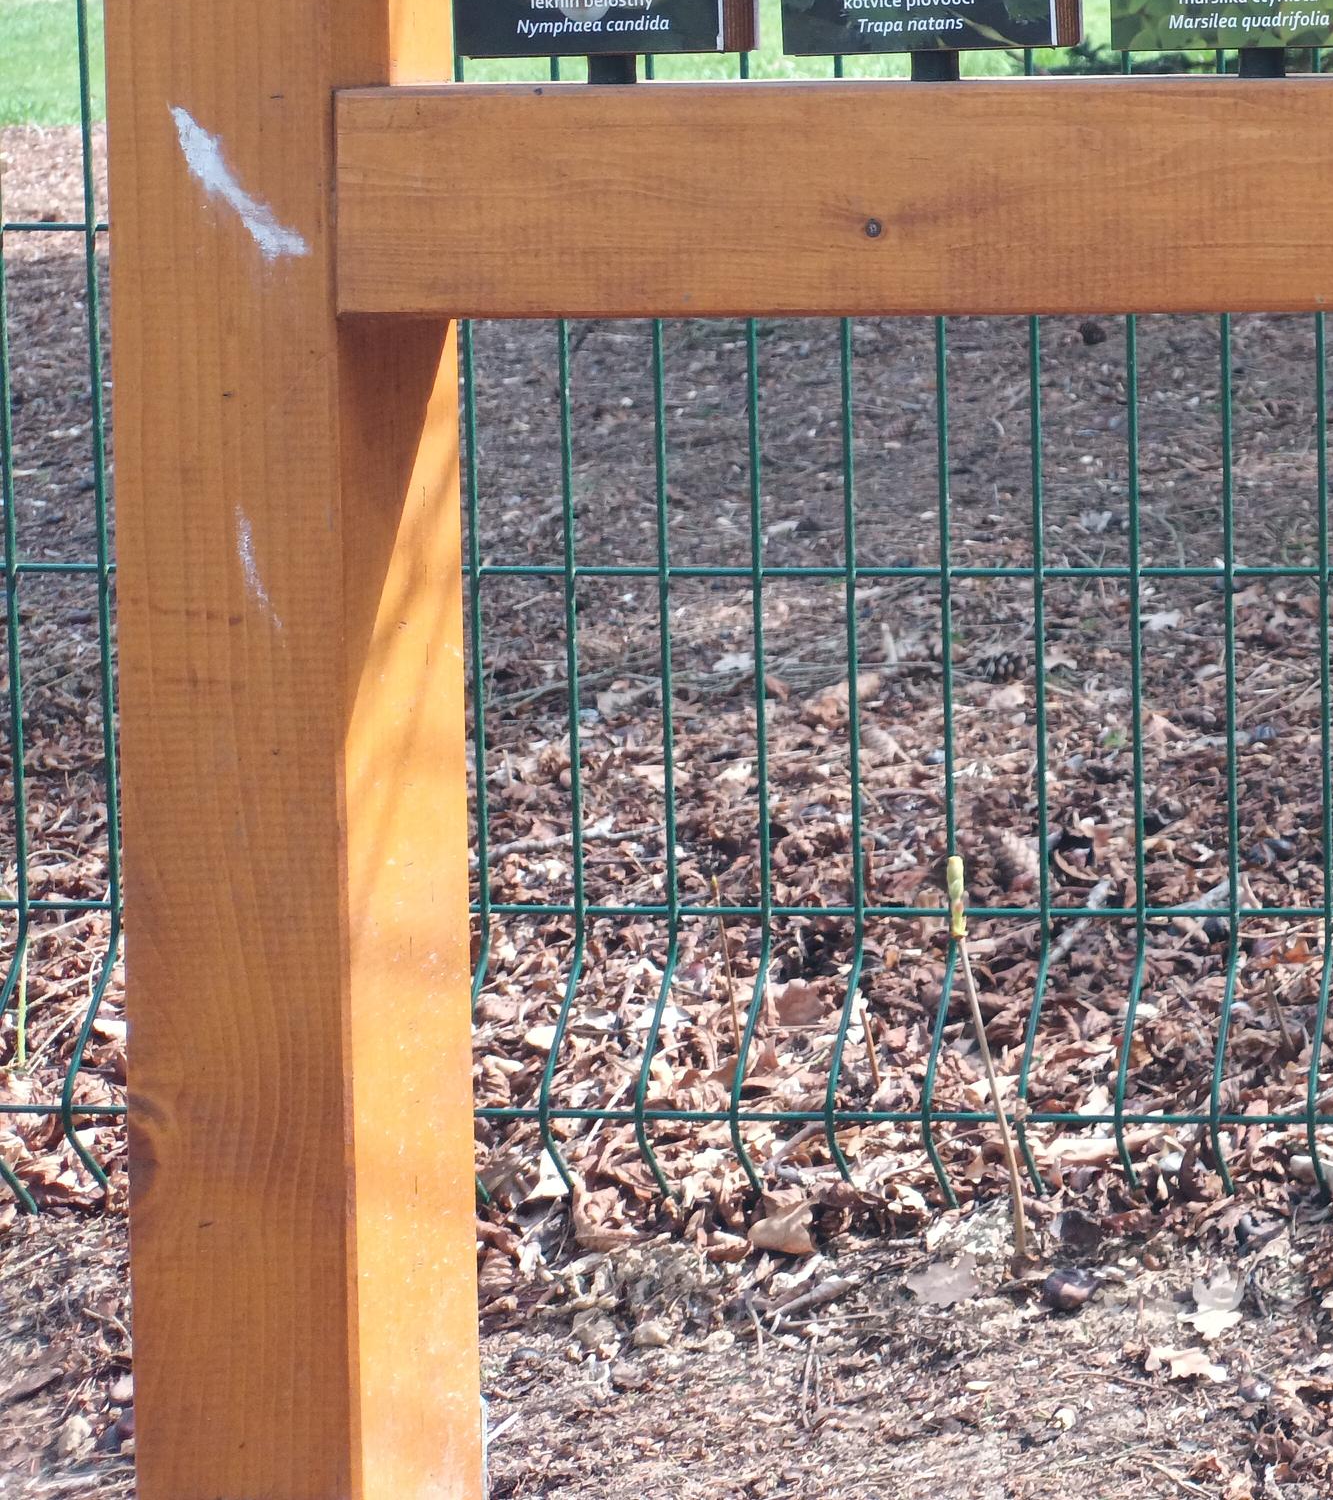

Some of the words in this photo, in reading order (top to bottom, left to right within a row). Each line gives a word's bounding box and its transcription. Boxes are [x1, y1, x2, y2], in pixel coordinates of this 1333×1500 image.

[517, 19, 601, 38] Nymphaea
[606, 15, 669, 31] candida
[857, 18, 903, 36] Trapa
[907, 17, 963, 31] natans
[1169, 13, 1237, 29] Marsilea
[1242, 10, 1330, 31] quadrifolia
